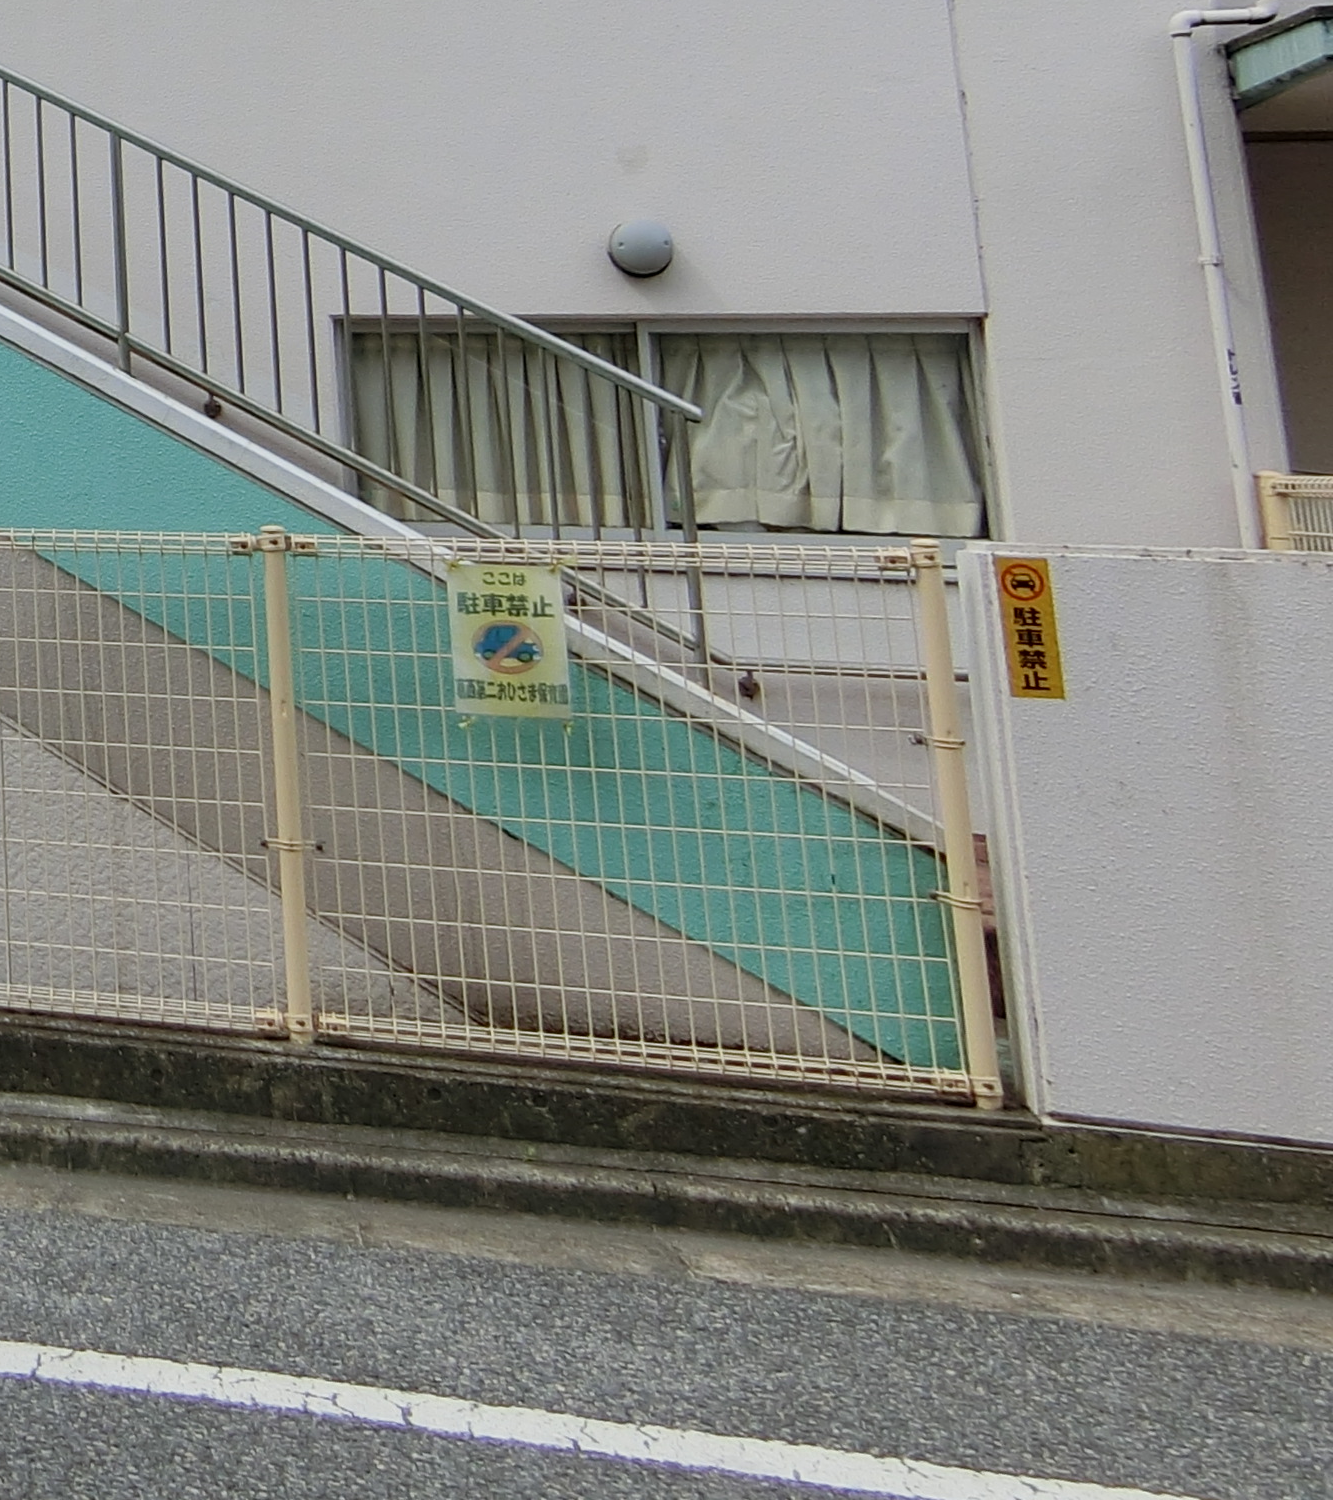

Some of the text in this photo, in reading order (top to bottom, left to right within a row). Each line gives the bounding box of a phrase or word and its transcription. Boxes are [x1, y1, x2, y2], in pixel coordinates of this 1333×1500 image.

[482, 571, 527, 586] ここは
[456, 591, 555, 618] 駐車禁止
[1013, 607, 1051, 691] 駐車禁止
